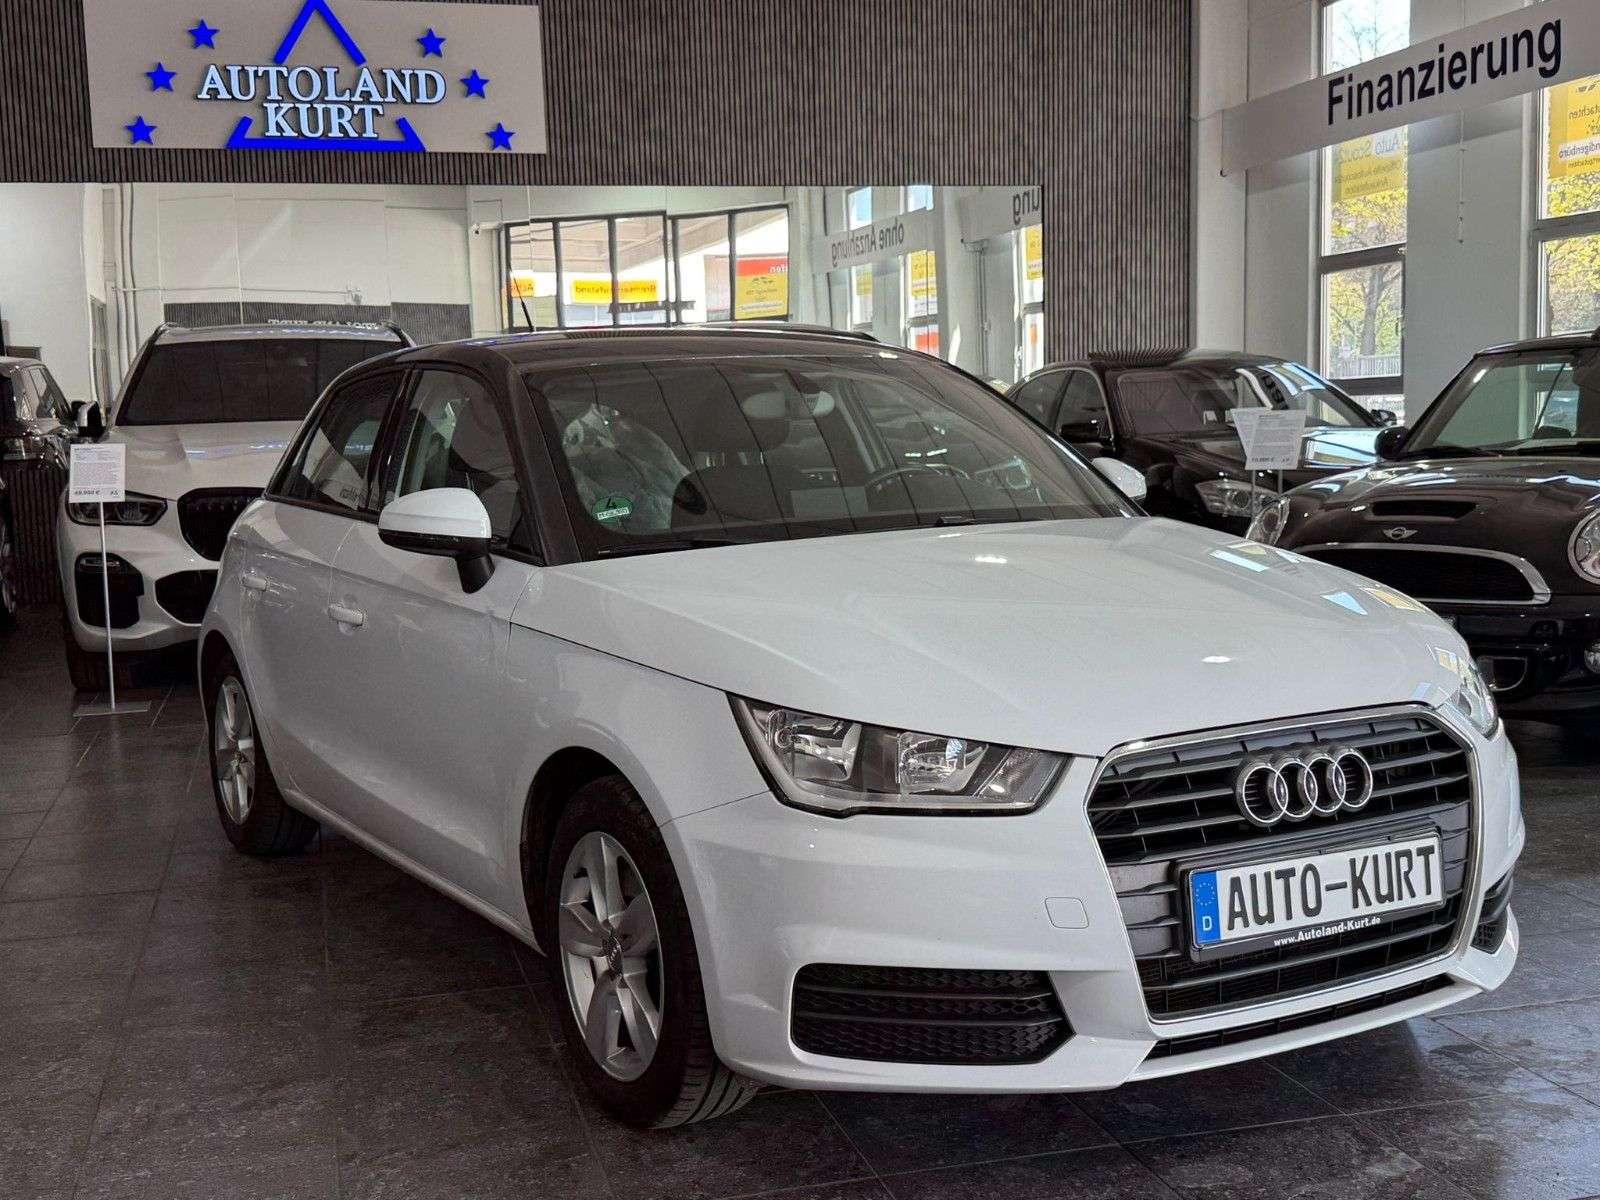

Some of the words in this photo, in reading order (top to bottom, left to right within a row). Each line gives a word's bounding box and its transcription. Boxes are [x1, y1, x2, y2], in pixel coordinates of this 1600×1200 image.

[197, 64, 447, 104] AUTOLAND
[1327, 18, 1562, 126] Finanzierung
[262, 102, 384, 139] KURT
[1227, 845, 1435, 931] AUTO-KURT
[1202, 915, 1213, 932] D
[1273, 916, 1382, 947] www.Autoland-Kurt.de
